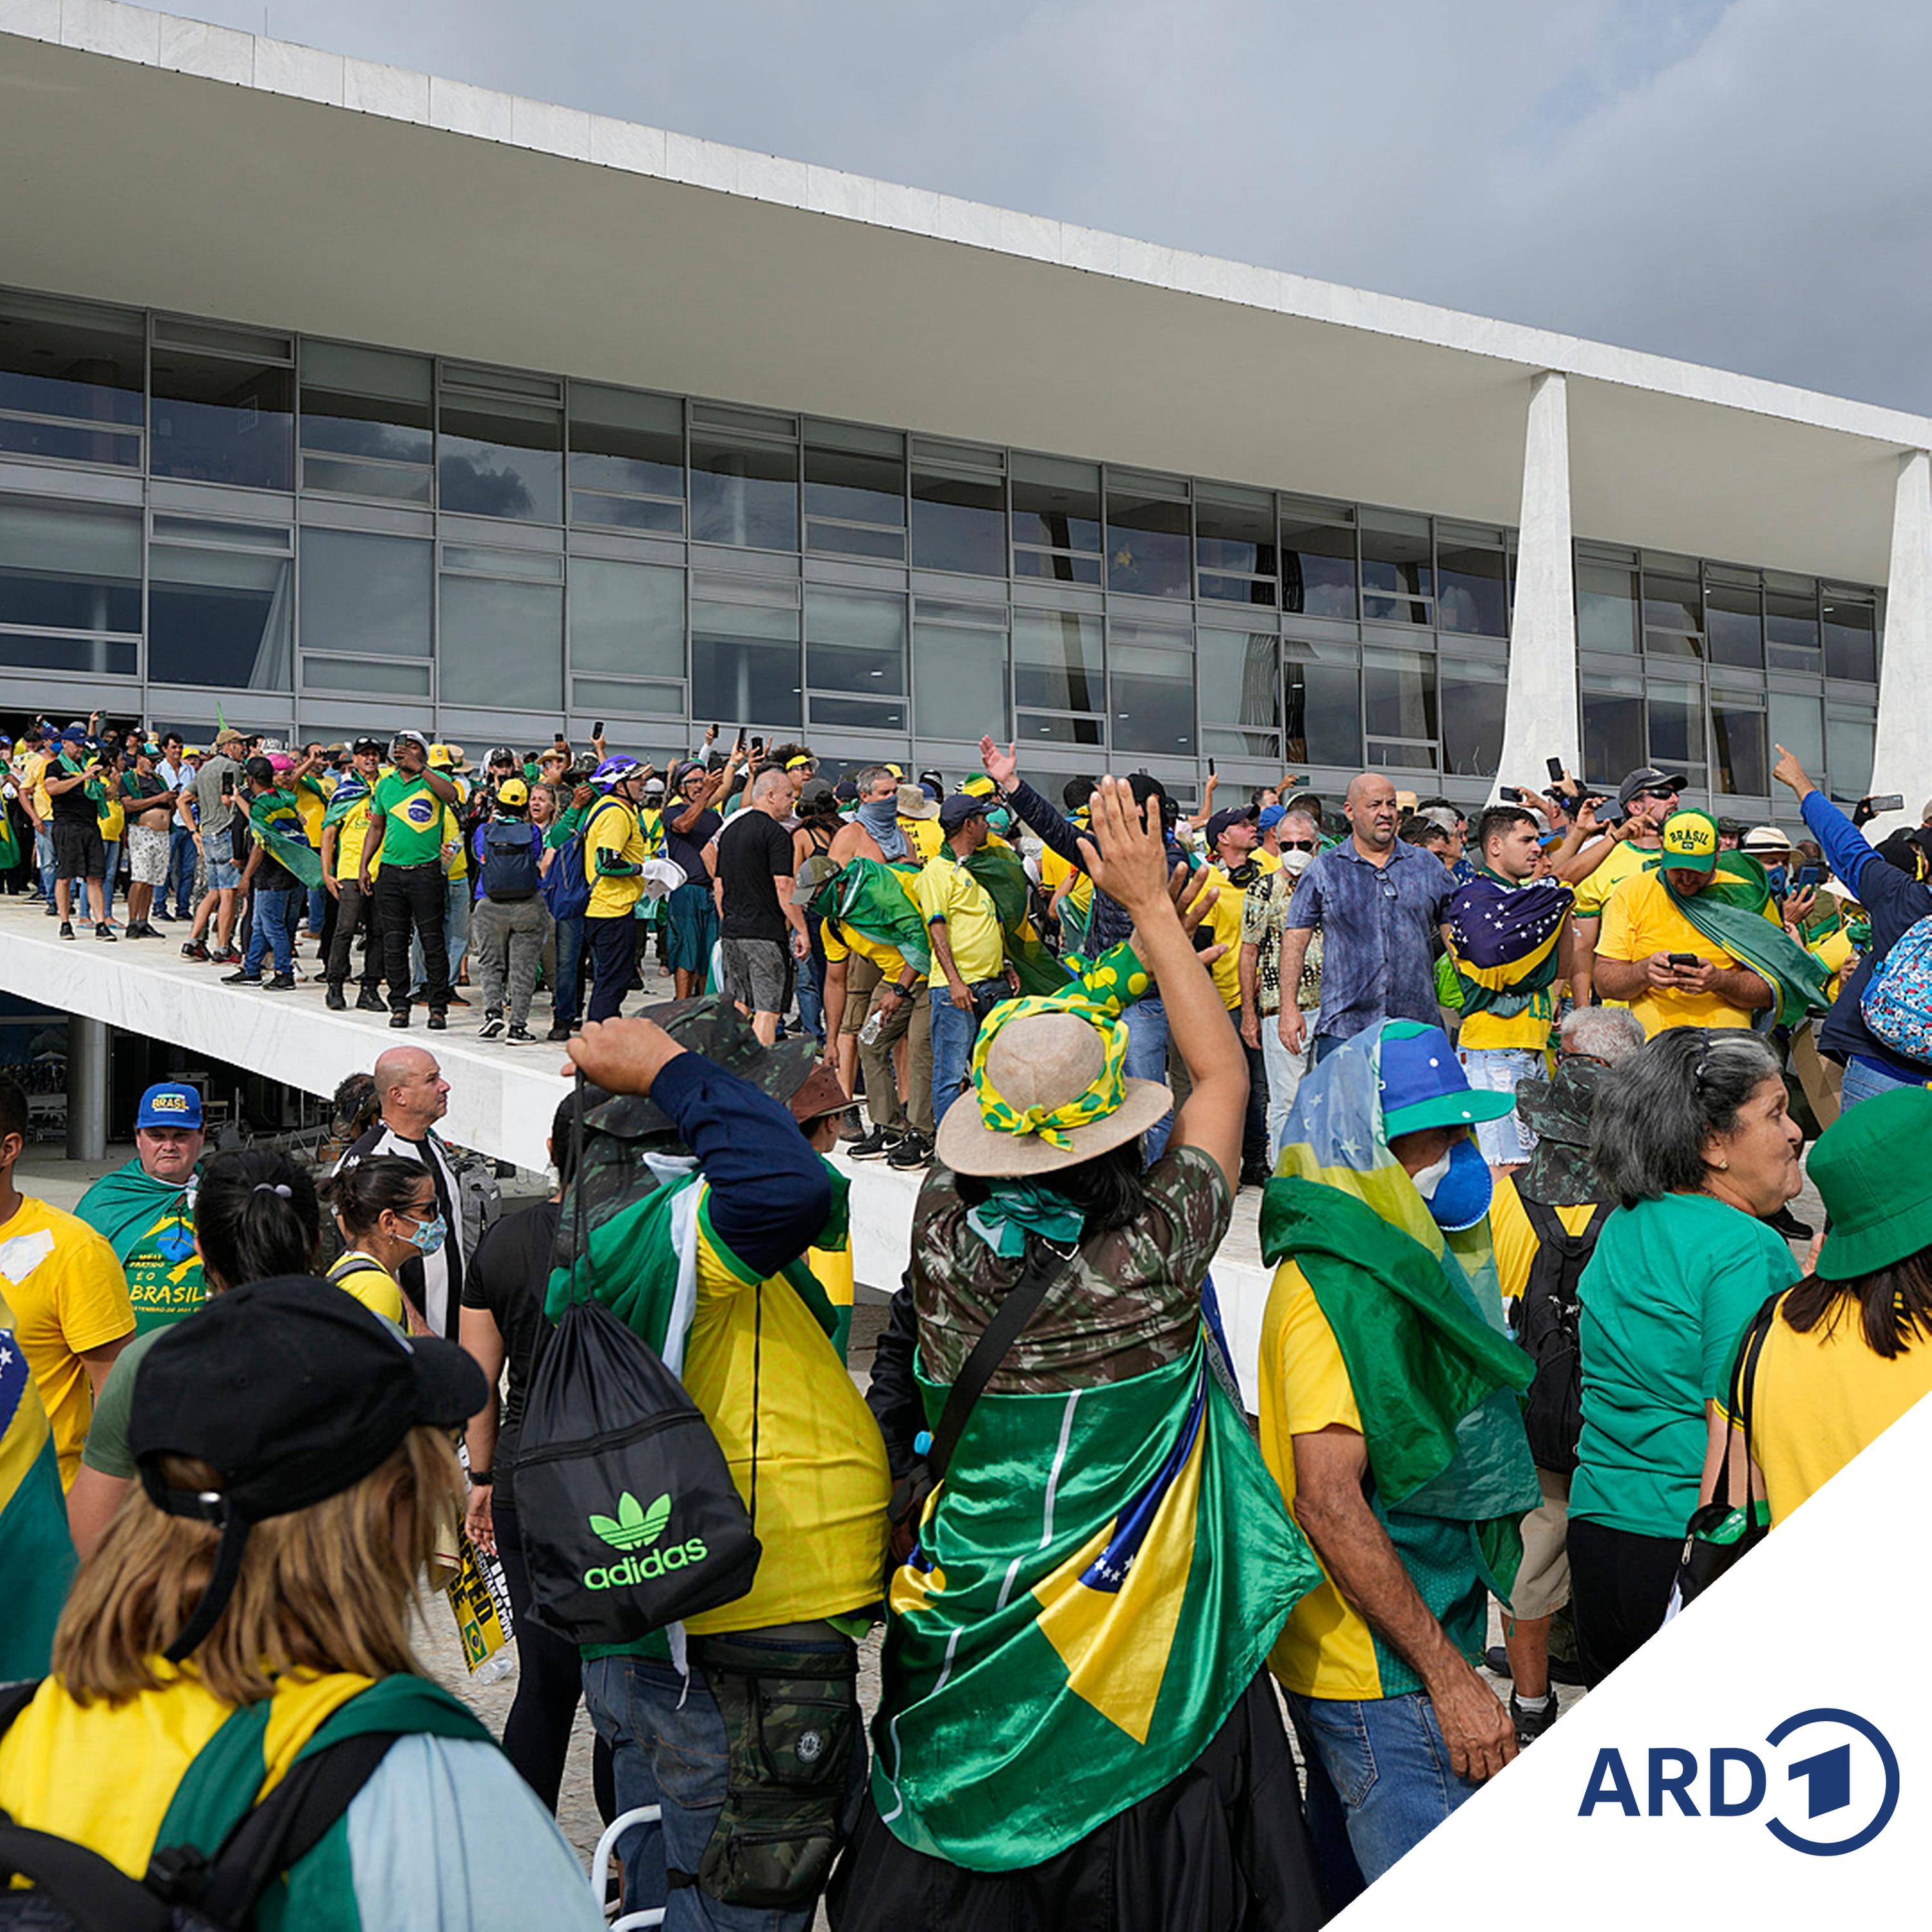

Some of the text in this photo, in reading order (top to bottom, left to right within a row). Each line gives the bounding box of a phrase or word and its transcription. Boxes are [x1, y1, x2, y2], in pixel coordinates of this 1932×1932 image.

[1669, 829, 1709, 846] BRASIL
[151, 1097, 189, 1110] BRASIL
[146, 1272, 155, 1280] O
[129, 1283, 206, 1304] BRASIL
[583, 1537, 708, 1590] adidas
[498, 1607, 514, 1640] POVO
